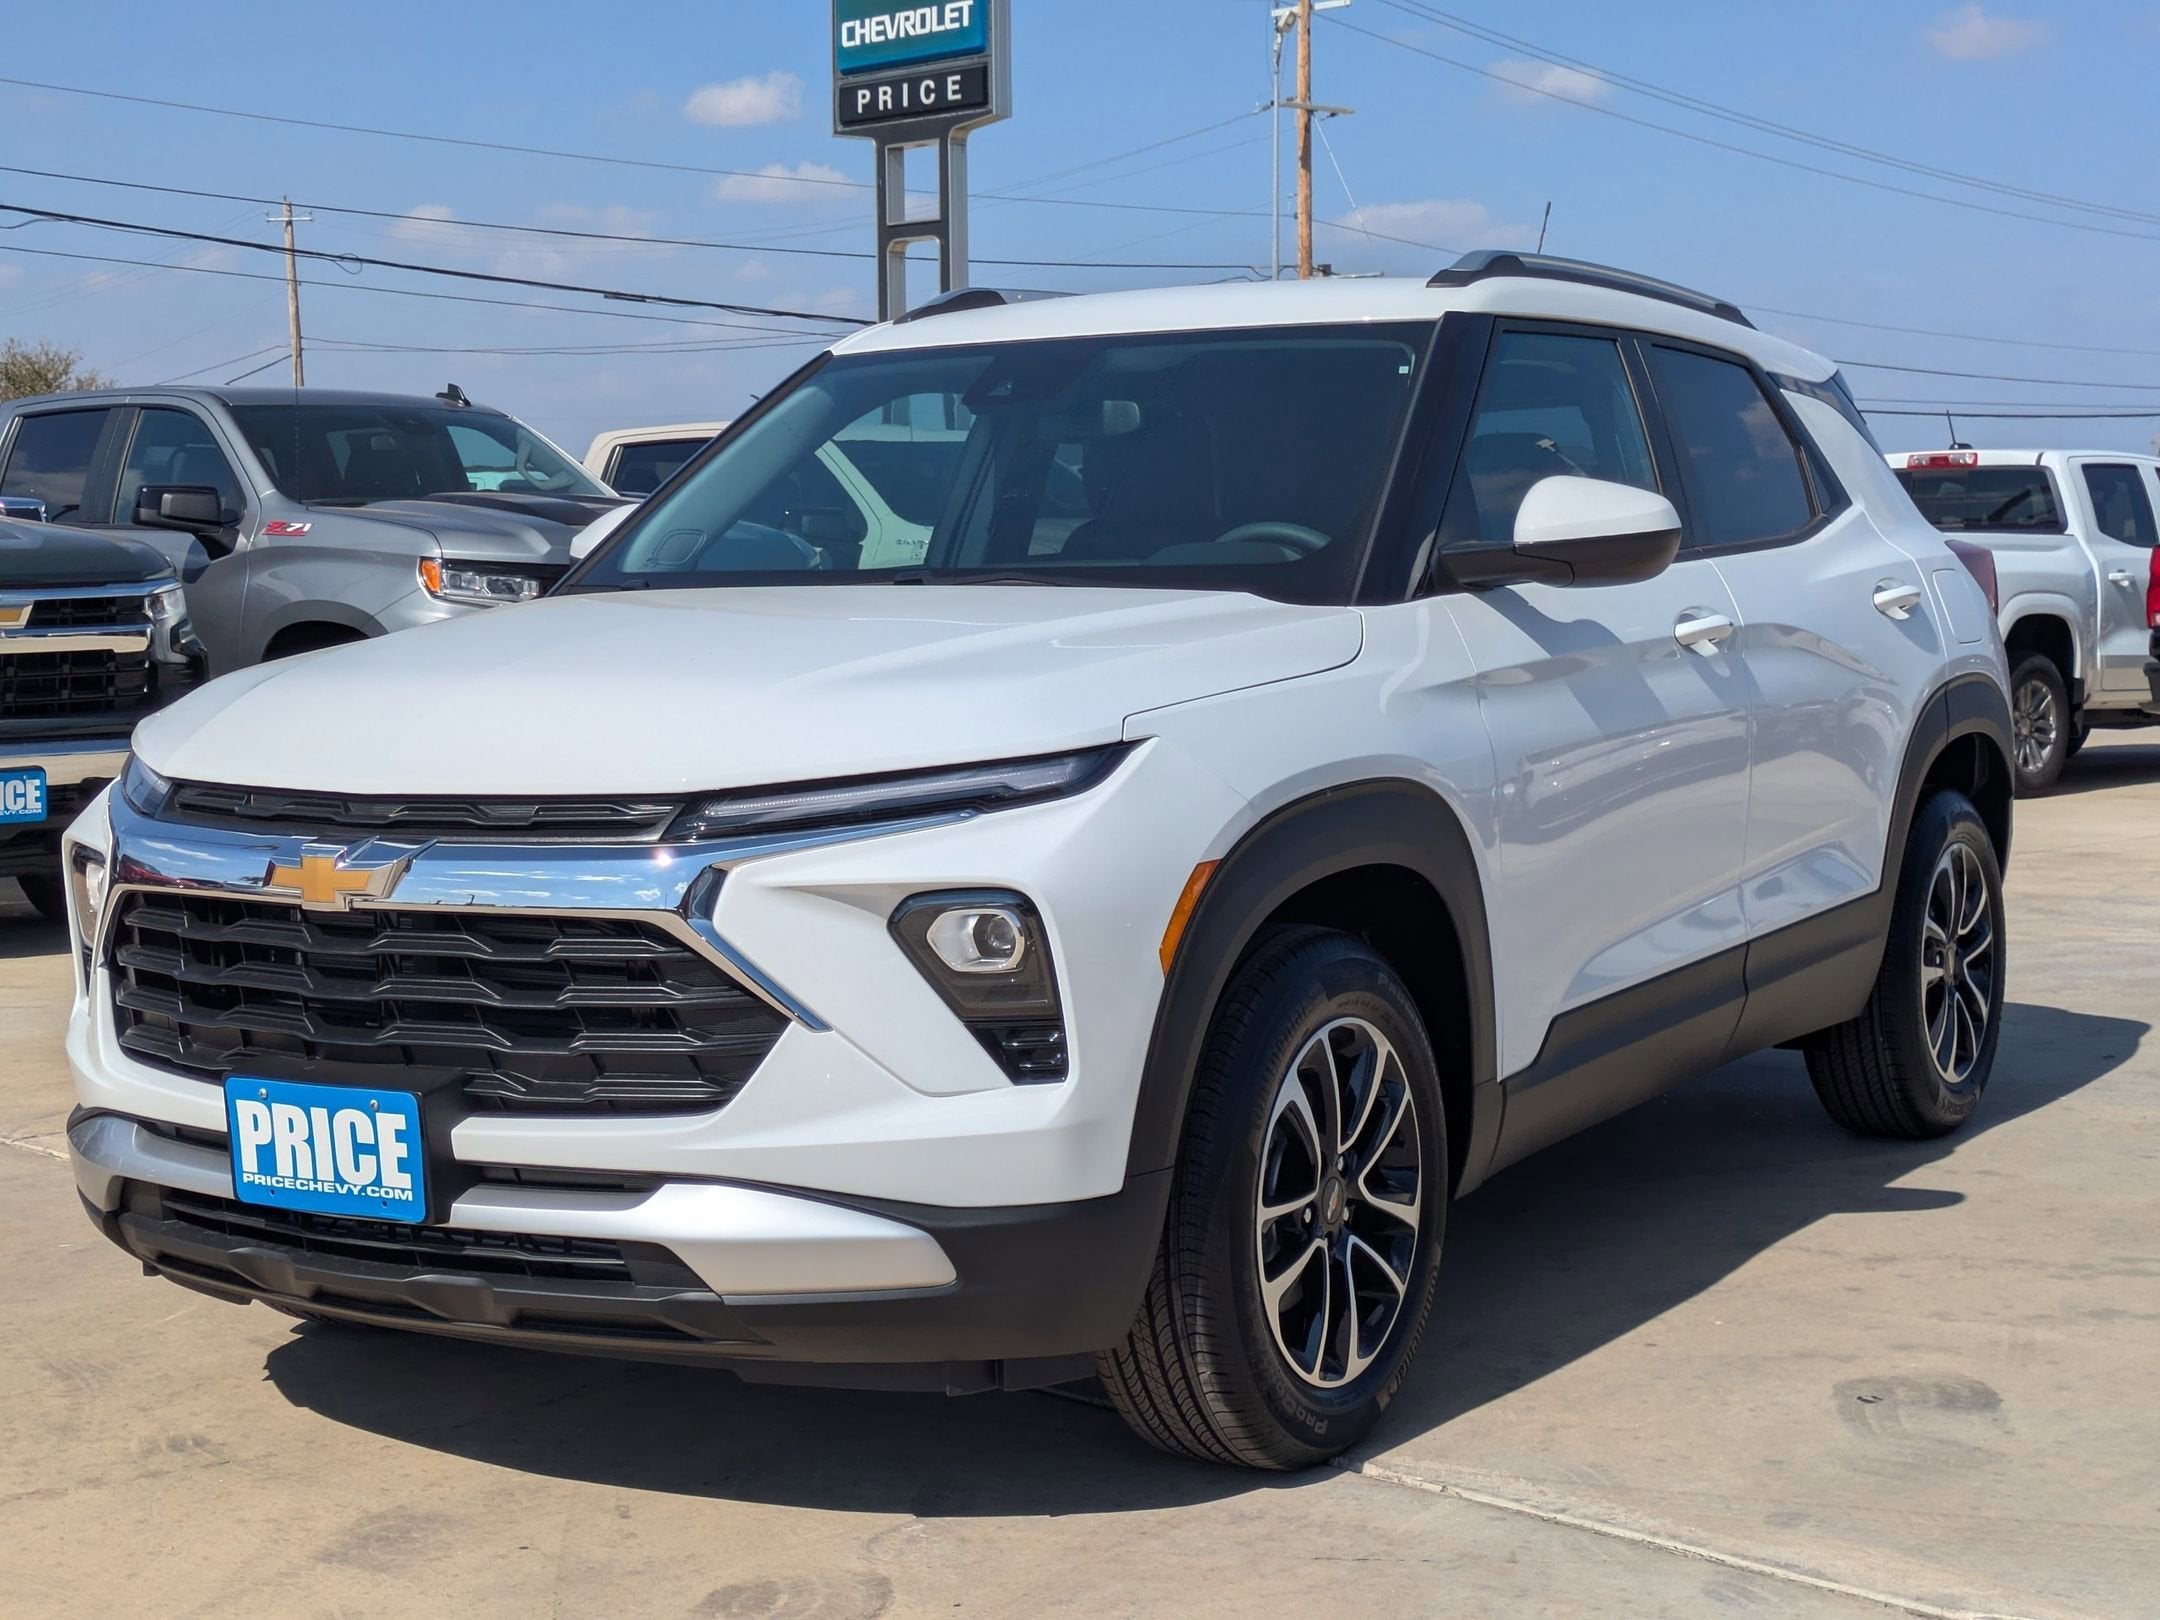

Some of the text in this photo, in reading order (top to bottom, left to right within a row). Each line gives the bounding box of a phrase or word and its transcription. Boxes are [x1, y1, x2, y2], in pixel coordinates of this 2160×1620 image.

[841, 0, 973, 47] CHEVROLET
[857, 75, 962, 114] PRICE
[264, 521, 313, 535] Z71
[235, 1099, 412, 1190] PRICE
[242, 1172, 413, 1201] PRICECHEVY.COM
